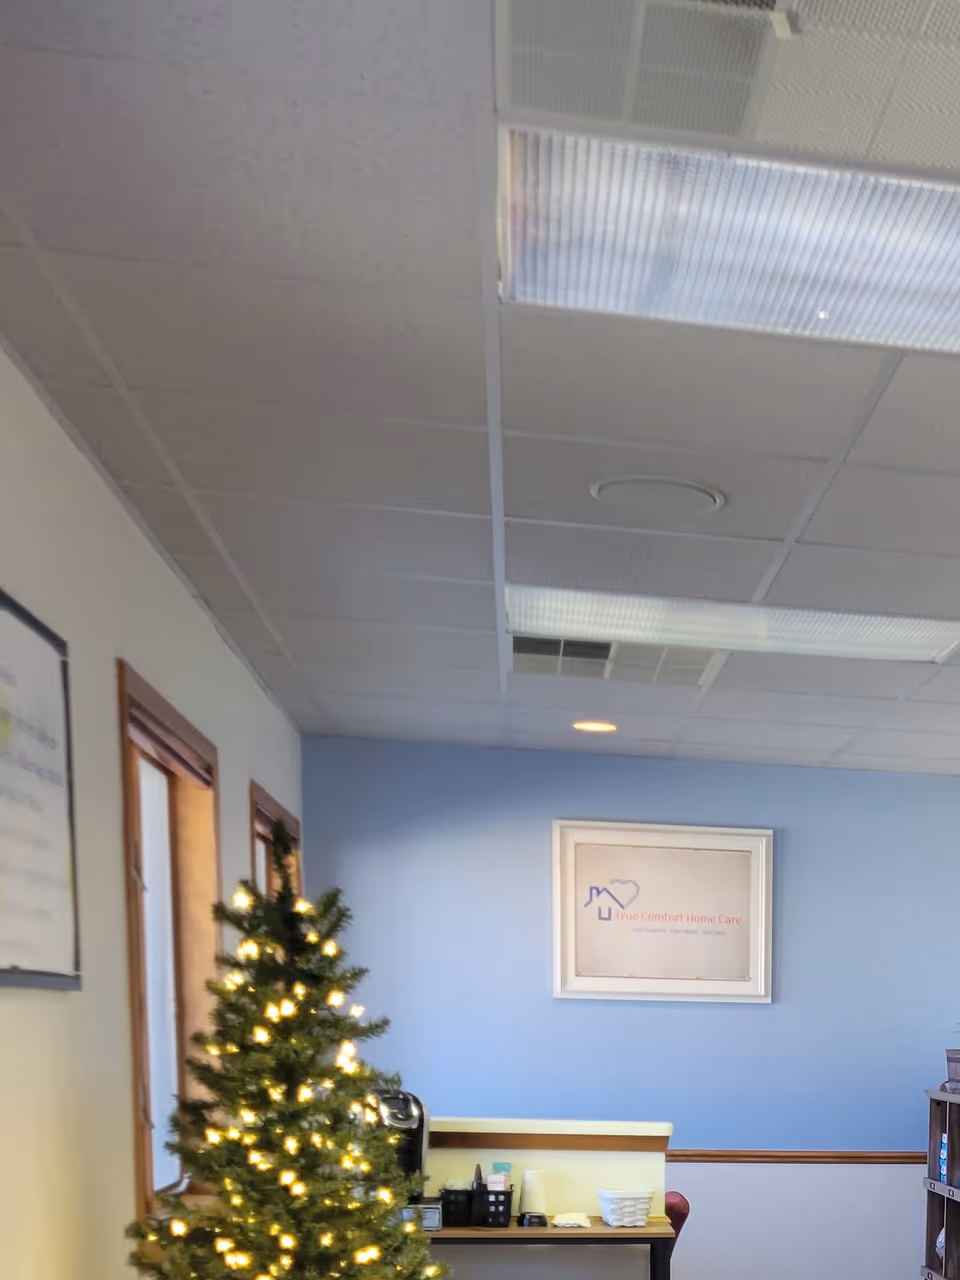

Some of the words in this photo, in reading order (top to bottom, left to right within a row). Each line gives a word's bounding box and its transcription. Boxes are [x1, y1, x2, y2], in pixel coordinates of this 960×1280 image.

[616, 912, 638, 921] True
[640, 912, 684, 923] Comfort
[686, 913, 716, 924] Home
[718, 914, 743, 925] Care
